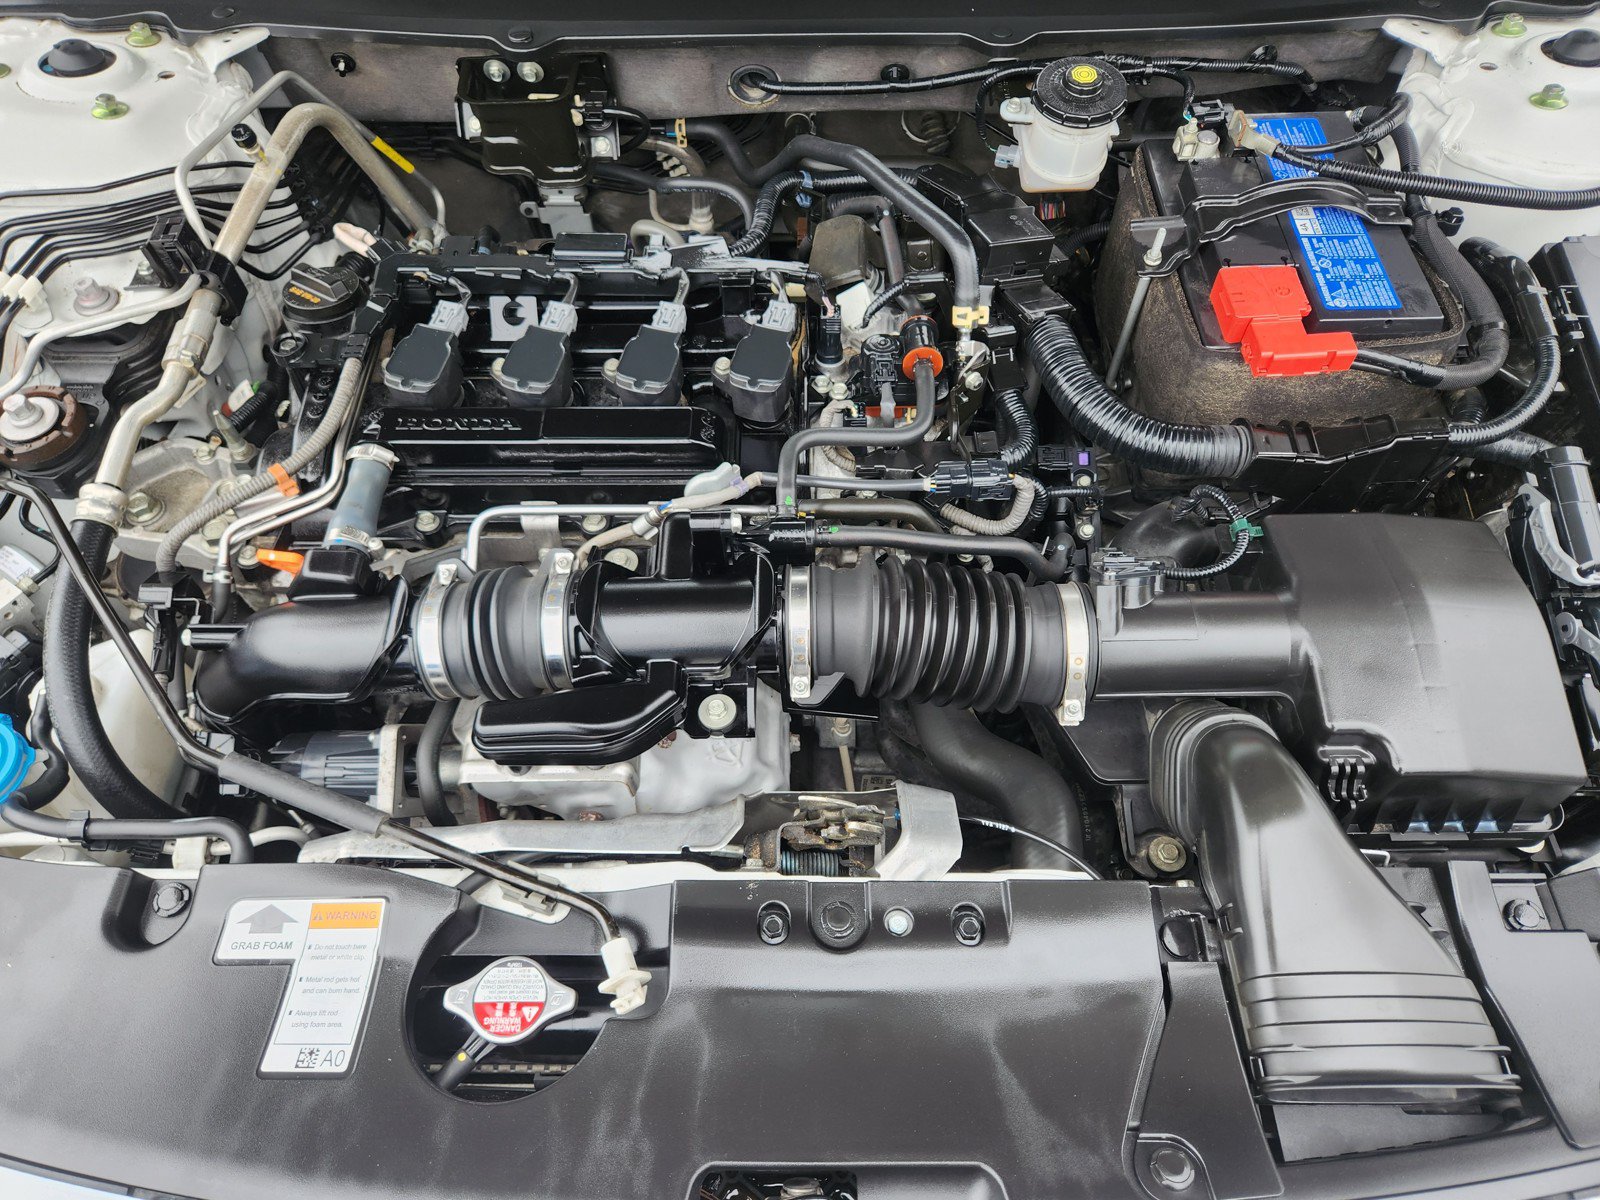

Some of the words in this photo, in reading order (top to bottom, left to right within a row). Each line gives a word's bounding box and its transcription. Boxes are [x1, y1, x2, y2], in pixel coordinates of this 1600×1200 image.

[395, 417, 522, 431] HONDA
[326, 911, 377, 920] WARNING
[230, 941, 261, 950] GRAB
[263, 941, 293, 950] FOAM
[489, 1024, 521, 1032] DANGER
[320, 1050, 345, 1067] A0
